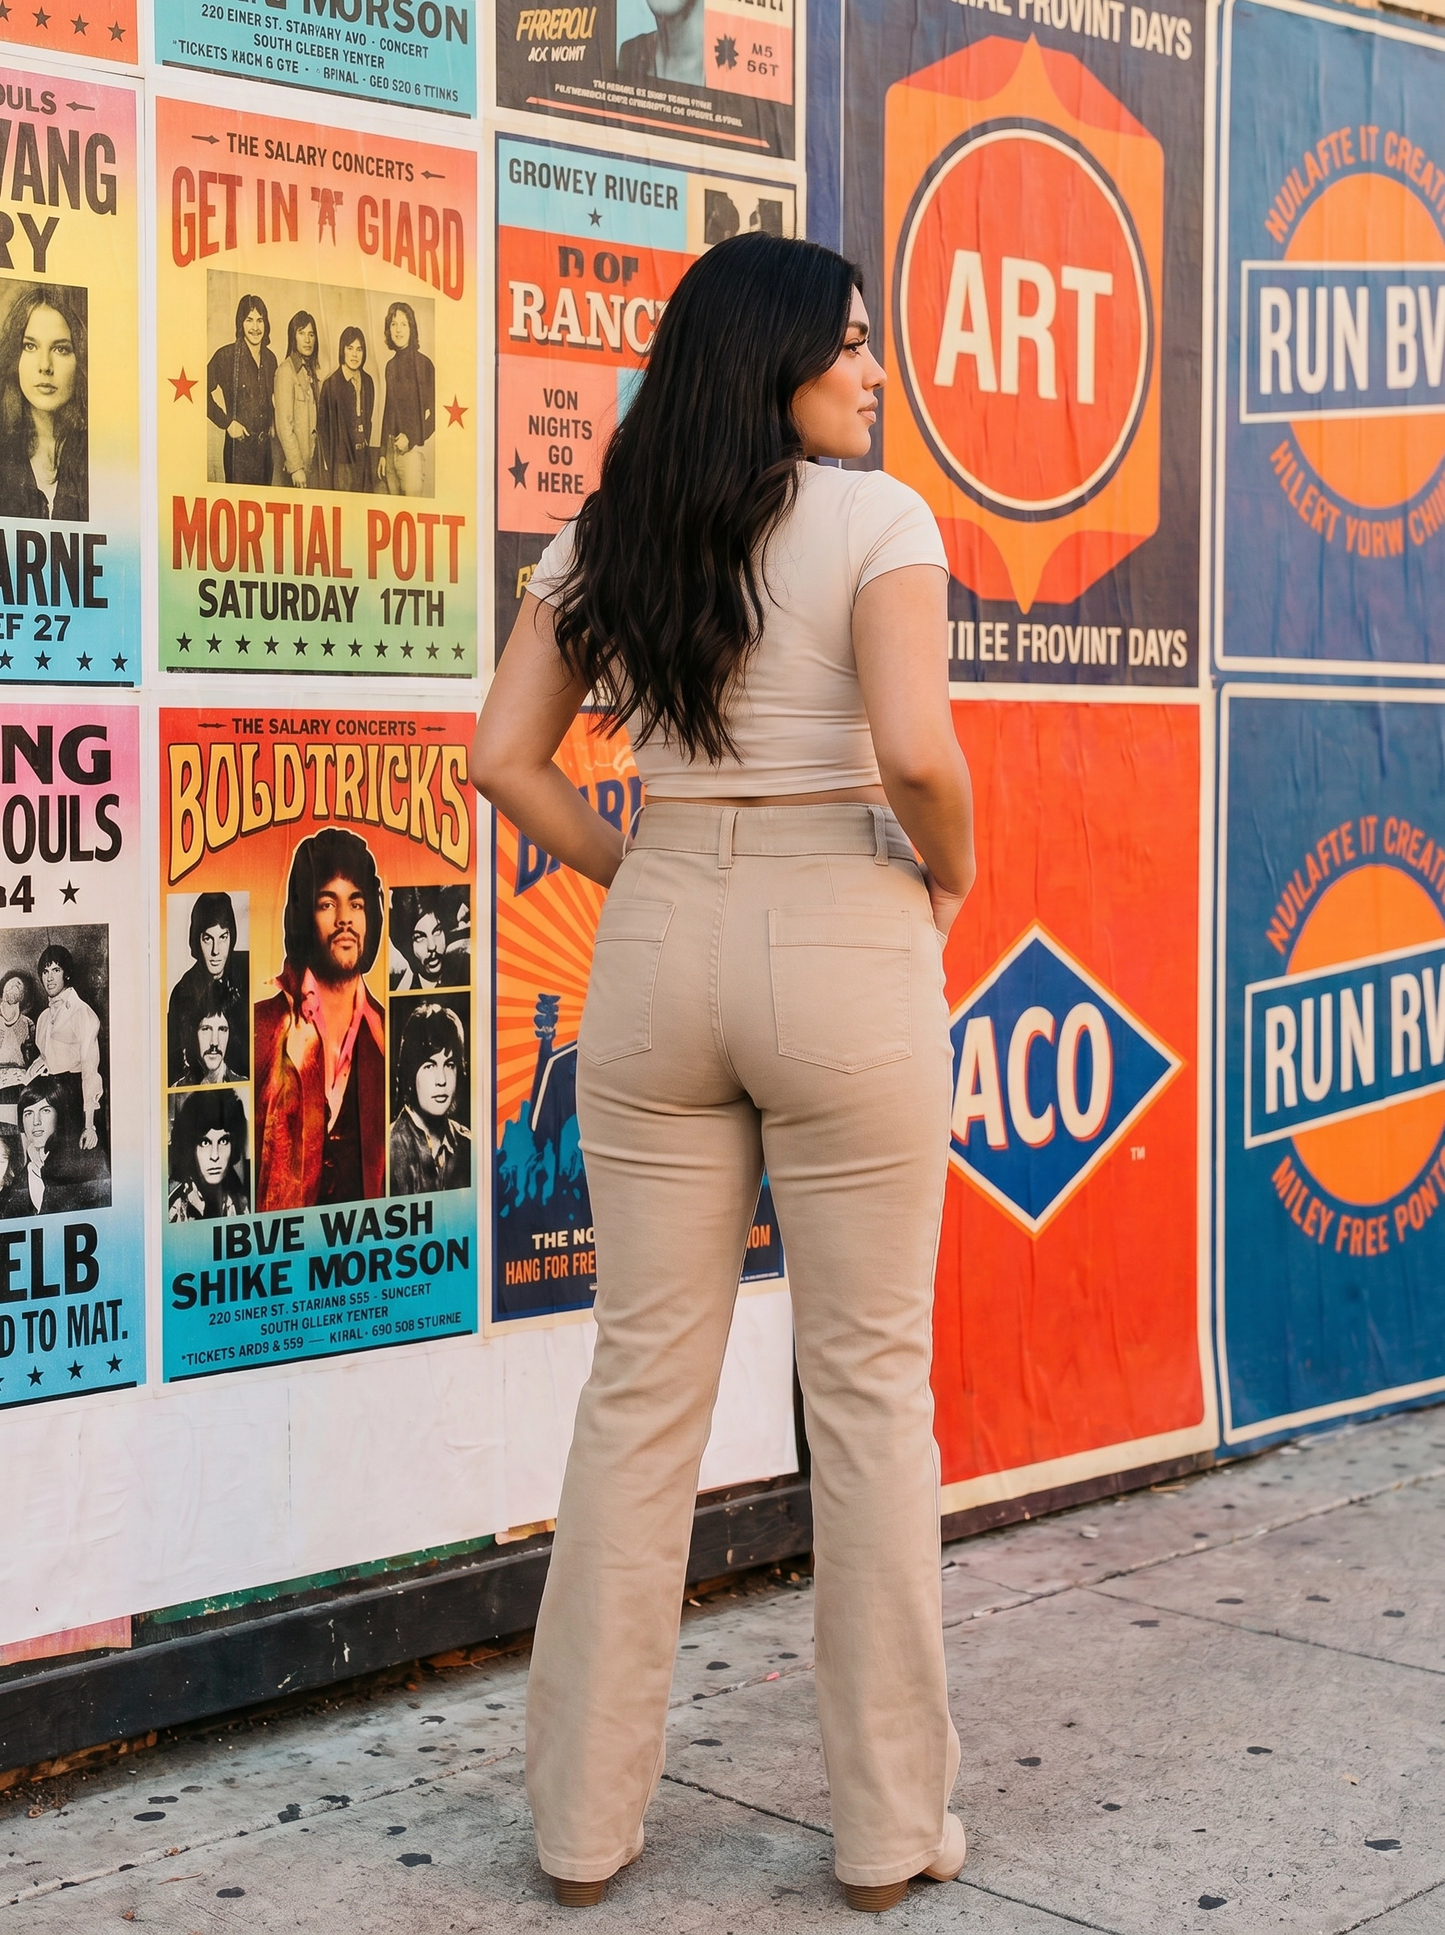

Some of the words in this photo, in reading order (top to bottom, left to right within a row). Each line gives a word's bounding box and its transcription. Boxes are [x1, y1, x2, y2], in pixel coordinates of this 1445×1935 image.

[201, 3, 224, 20] 220
[227, 8, 262, 27] EINER
[265, 15, 282, 31] ST.
[345, 31, 367, 46] AVO
[380, 37, 429, 59] CONCERT
[254, 33, 292, 52] SOUTH
[296, 41, 339, 61] GLEBER
[343, 49, 385, 69] YENYER
[1130, 6, 1193, 61] DAYS
[266, 55, 273, 69] 6
[414, 83, 421, 96] 6
[226, 132, 259, 157] THE
[264, 139, 327, 167] SALARY
[332, 151, 415, 182] CONCERTS
[1359, 125, 1379, 162] IT
[509, 157, 598, 197] GROWEY
[605, 174, 679, 211] RIVGER
[172, 165, 243, 268] GET
[257, 178, 298, 244] IN
[357, 194, 464, 301] GIARD
[507, 280, 668, 356] RANC
[933, 248, 1113, 405] ART
[1259, 286, 1369, 395] RUN
[543, 388, 578, 411] VON
[528, 415, 593, 440] NIGHTS
[548, 445, 573, 466] GO
[537, 471, 584, 495] HERE
[172, 495, 353, 579] MORTIAL
[367, 509, 466, 584] POTT
[198, 578, 360, 623] SATURDAY
[380, 587, 445, 627] 17TH
[0, 613, 24, 640] F
[34, 614, 71, 642] 27
[1017, 623, 1121, 665] FROVINT
[1128, 628, 1188, 668] DAYS
[232, 718, 264, 735] THE
[269, 719, 331, 735] SALARY
[335, 720, 417, 736] CONCERTS
[1, 724, 111, 785] NG
[2, 793, 122, 865] OULS
[1360, 815, 1378, 854] IT
[0, 875, 35, 913] 4
[1265, 983, 1375, 1114] RUN
[951, 1002, 1113, 1150] ACO
[1271, 1155, 1335, 1245] MILEY
[1335, 1214, 1389, 1257] FREE
[213, 1215, 305, 1262] IBVE
[320, 1200, 433, 1248] WASH
[531, 1230, 569, 1250] THE
[172, 1260, 293, 1310] SHIKE
[308, 1236, 469, 1291] MORSON
[506, 1258, 540, 1285] HANG
[544, 1254, 569, 1280] FOR
[22, 1308, 57, 1354] TO
[67, 1299, 128, 1348] MAT.
[209, 1310, 231, 1326] 220
[234, 1306, 268, 1322] SINER
[271, 1302, 289, 1317] ST.
[381, 1283, 432, 1300] SUNCERT
[260, 1318, 298, 1336] SOUTH
[302, 1311, 343, 1330] GLLERK
[272, 1340, 281, 1352] &
[283, 1336, 304, 1351] 559
[329, 1328, 363, 1344] KIRAL
[372, 1323, 392, 1337] 690
[395, 1319, 415, 1333] 508
